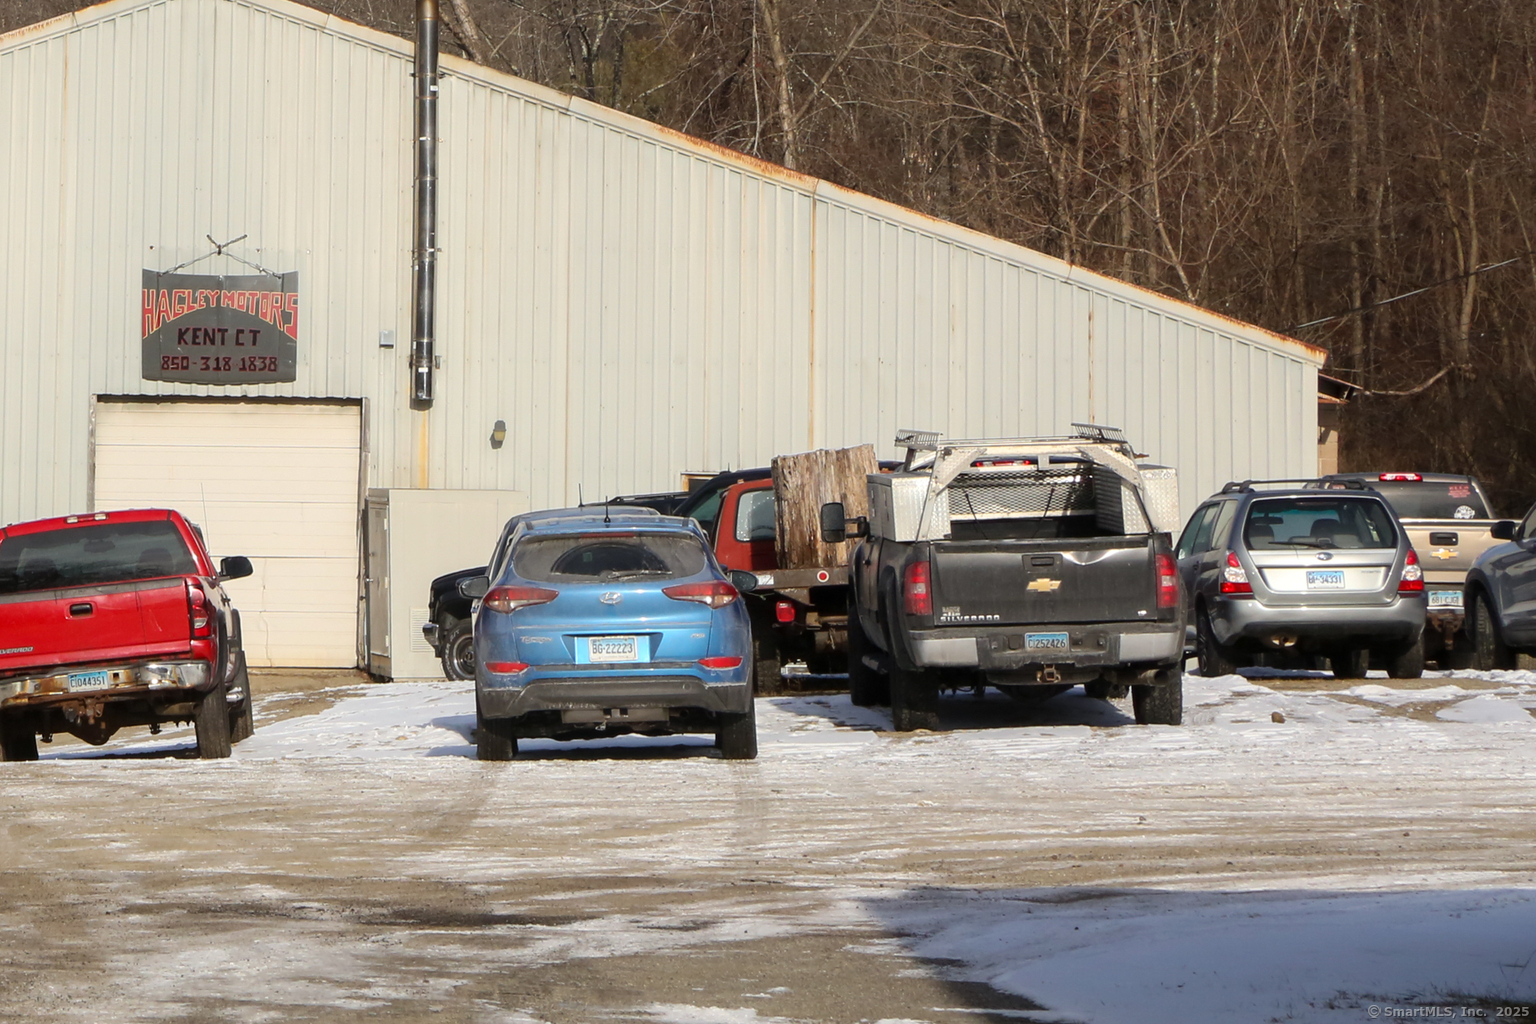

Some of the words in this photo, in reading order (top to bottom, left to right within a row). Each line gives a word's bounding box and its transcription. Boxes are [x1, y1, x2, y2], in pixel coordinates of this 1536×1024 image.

[142, 289, 220, 340] HAGLEY
[221, 290, 298, 341] MOTORS
[177, 327, 228, 346] KENT
